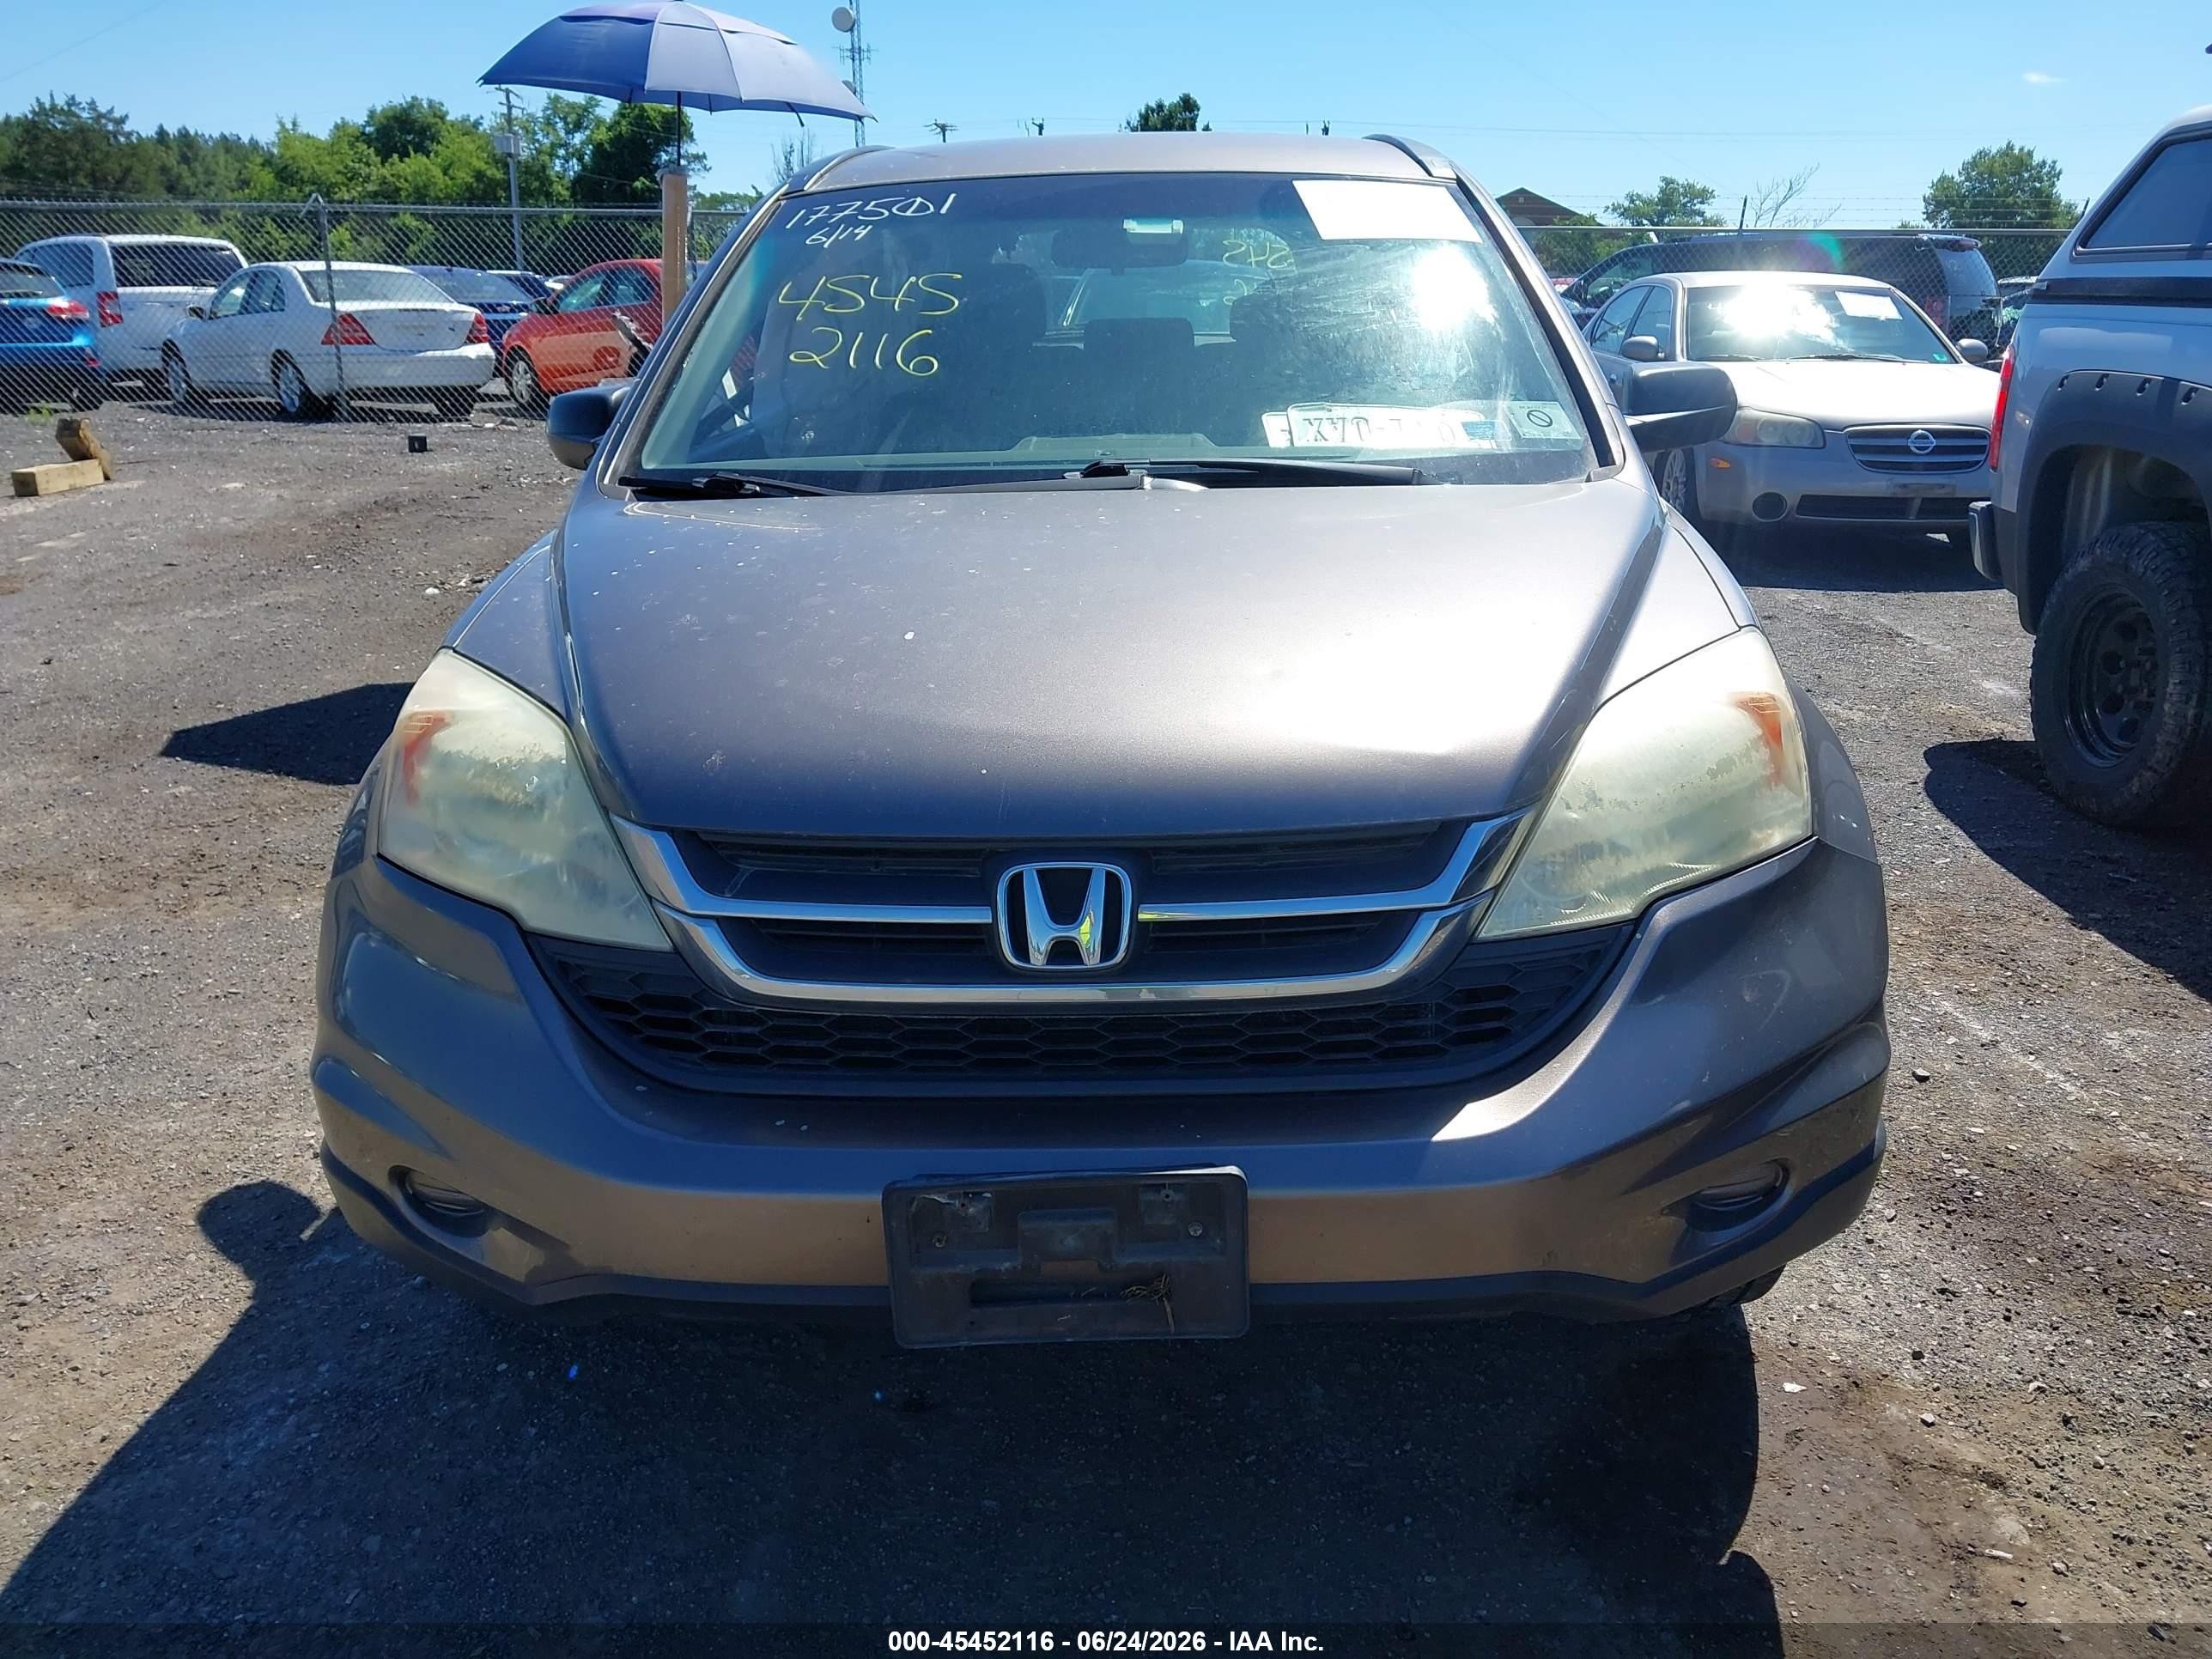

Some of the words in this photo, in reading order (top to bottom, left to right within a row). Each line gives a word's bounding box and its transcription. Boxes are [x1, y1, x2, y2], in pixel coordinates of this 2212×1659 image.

[785, 192, 957, 229] 177501
[805, 223, 873, 248] 6/14
[778, 272, 963, 322] 4545
[788, 326, 939, 376] 2116
